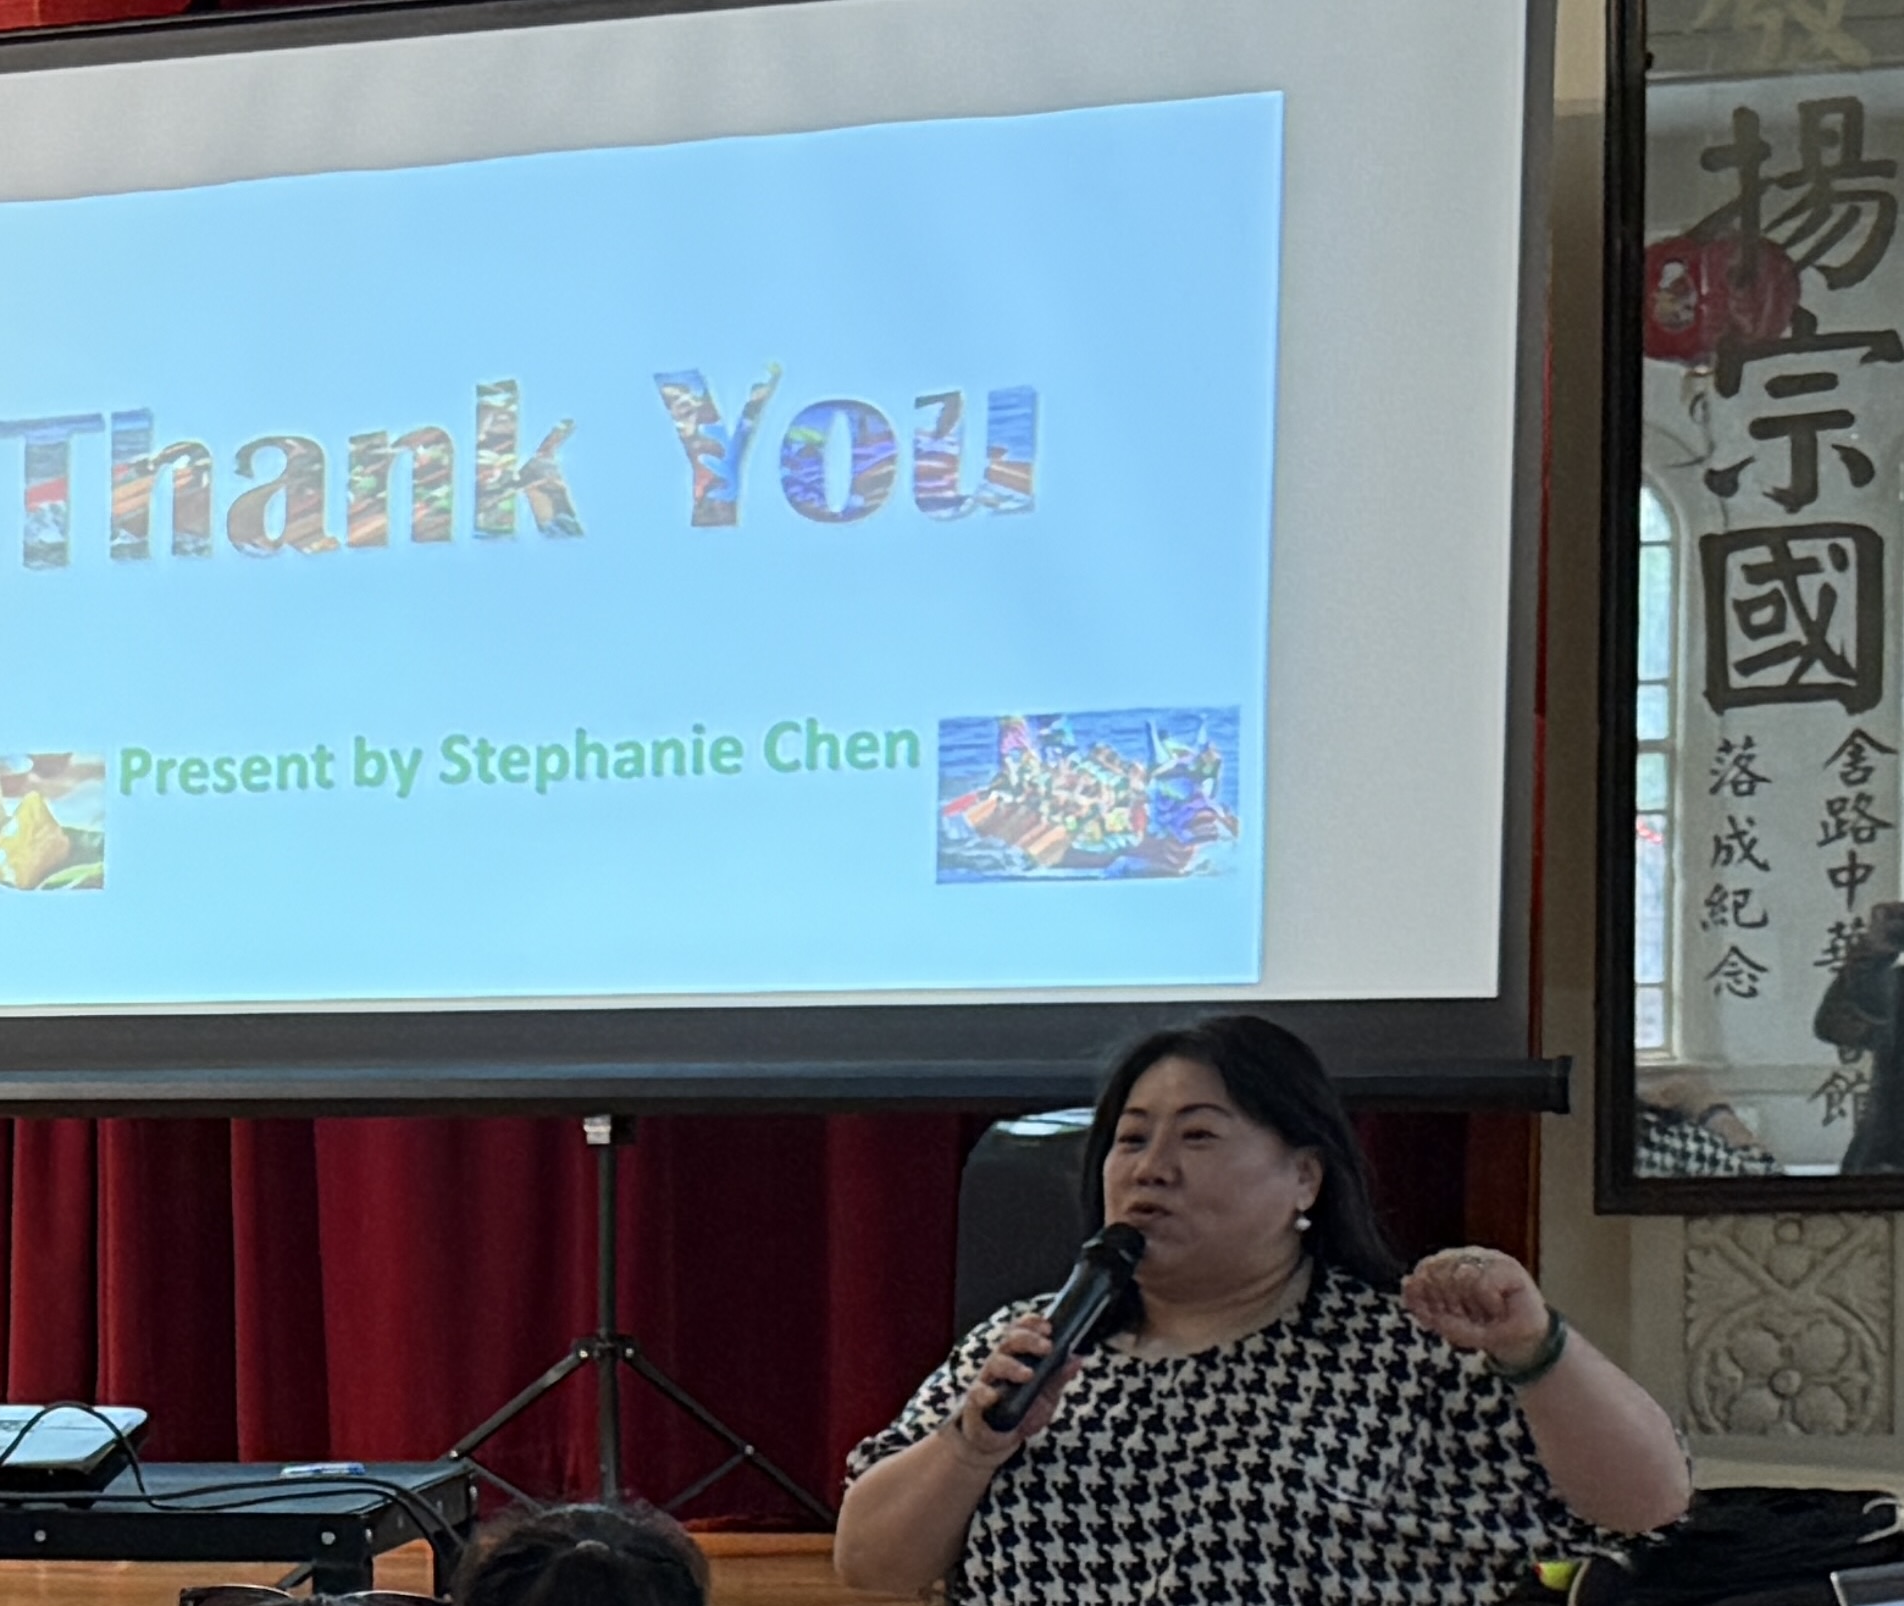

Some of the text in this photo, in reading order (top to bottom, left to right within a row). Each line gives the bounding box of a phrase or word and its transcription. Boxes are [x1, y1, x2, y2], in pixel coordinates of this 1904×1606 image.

[654, 362, 1038, 527] You
[118, 717, 921, 799] Present by Stephanie Chen
[1700, 735, 1772, 999] 落成紀念
